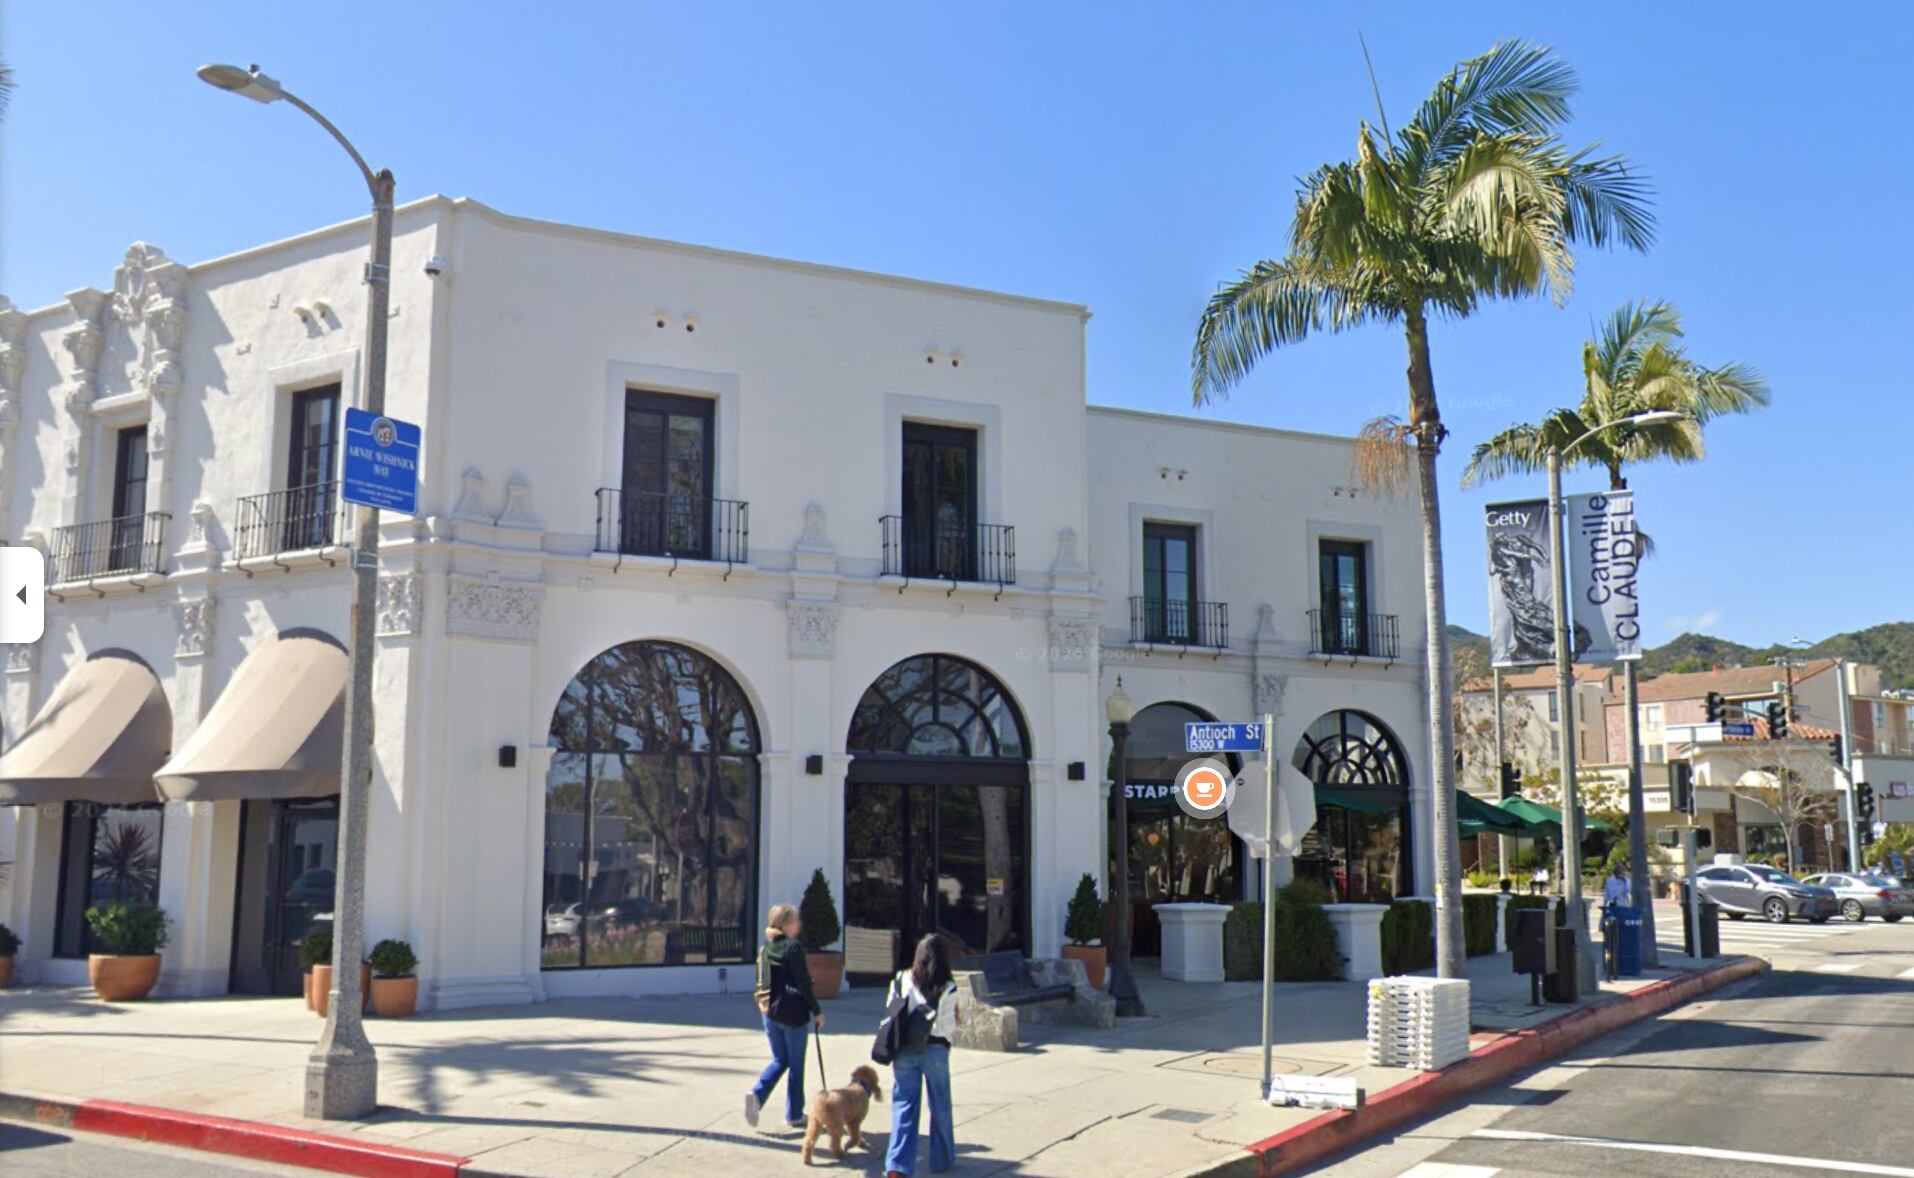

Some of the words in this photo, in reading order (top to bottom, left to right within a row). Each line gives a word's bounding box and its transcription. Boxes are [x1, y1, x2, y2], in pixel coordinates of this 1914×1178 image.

[348, 445, 373, 461] ARNIE
[375, 451, 415, 471] WISHNICK
[373, 464, 390, 477] WAY
[1485, 510, 1531, 528] Getty
[1582, 494, 1611, 605] Camille
[1611, 497, 1641, 642] CLAUDEL
[1190, 724, 1236, 741] Antioch
[1246, 724, 1260, 740] St
[1190, 740, 1216, 750] 15300
[1217, 740, 1225, 750] W
